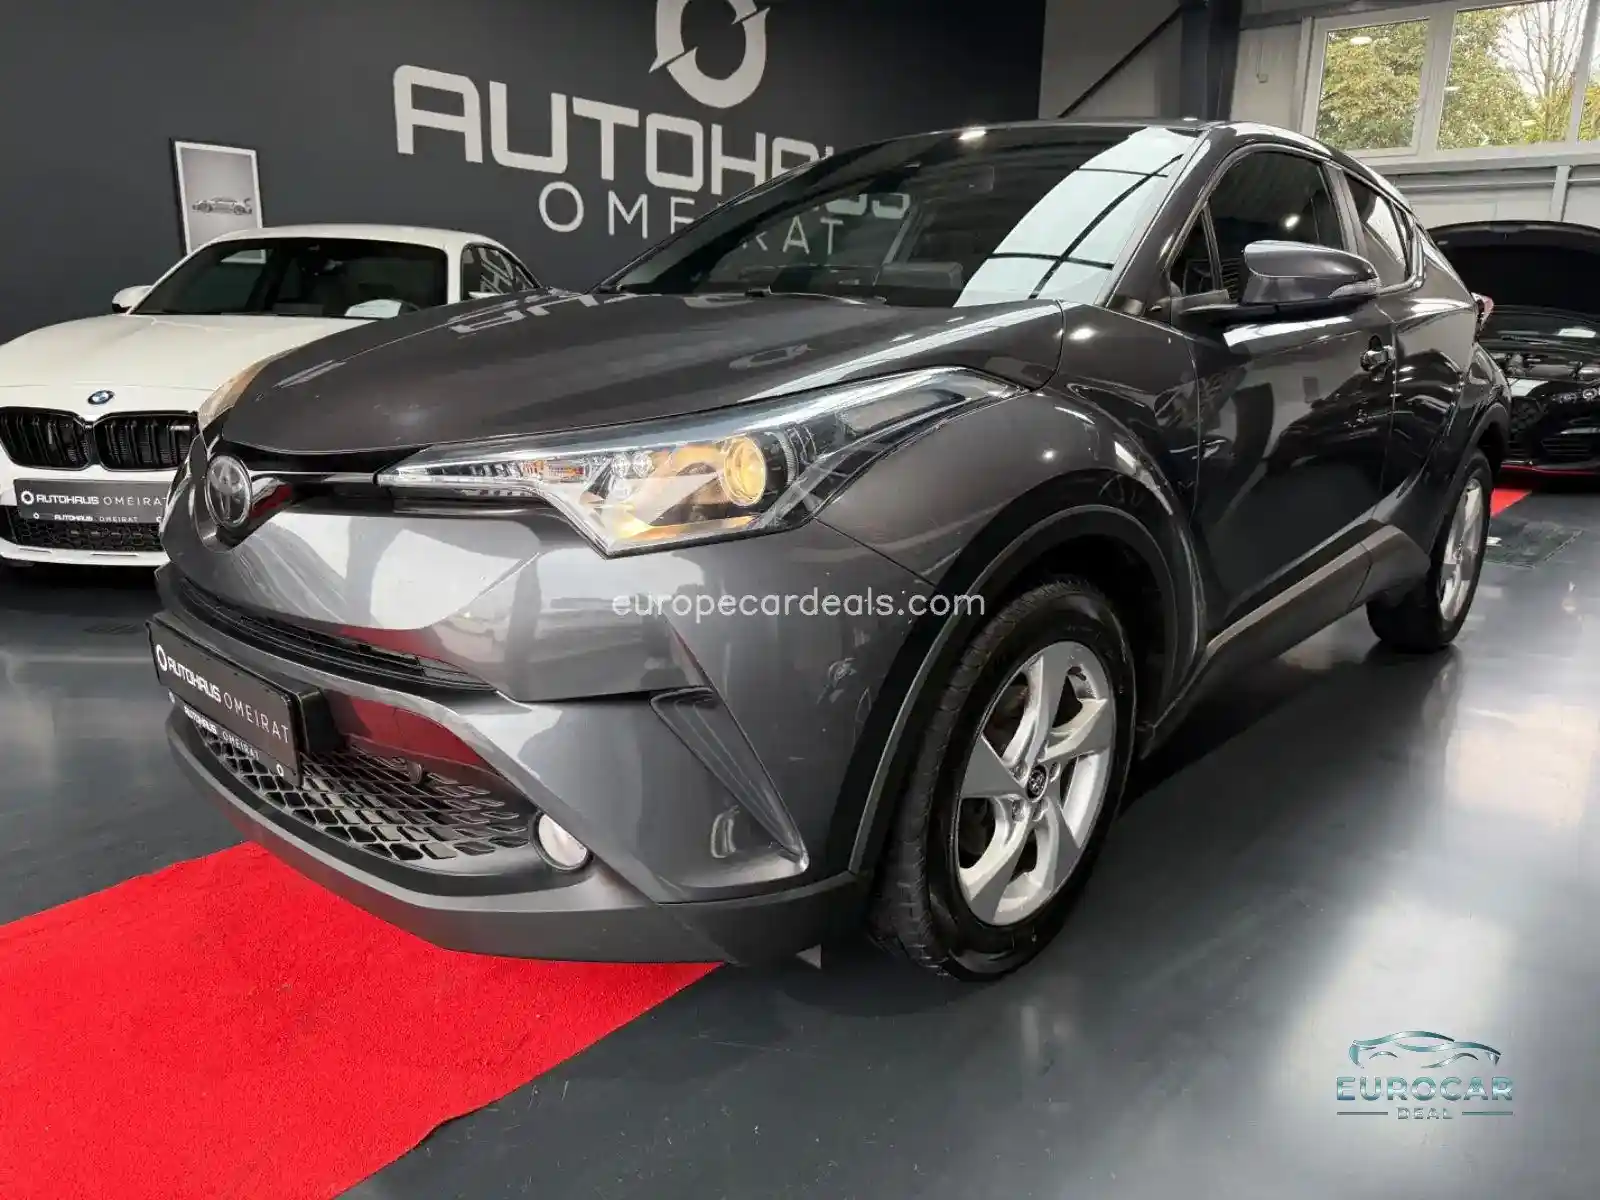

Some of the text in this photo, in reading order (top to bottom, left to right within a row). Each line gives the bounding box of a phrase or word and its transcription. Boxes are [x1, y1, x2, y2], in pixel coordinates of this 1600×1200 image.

[538, 181, 844, 255] OMEAT
[36, 493, 99, 505] AUTOHAUS
[54, 513, 93, 522] AUTOHAUS
[167, 656, 289, 744] AUTOHAUS OMEIRAT
[183, 704, 260, 761] AUTOHAUS OMEIRAT
